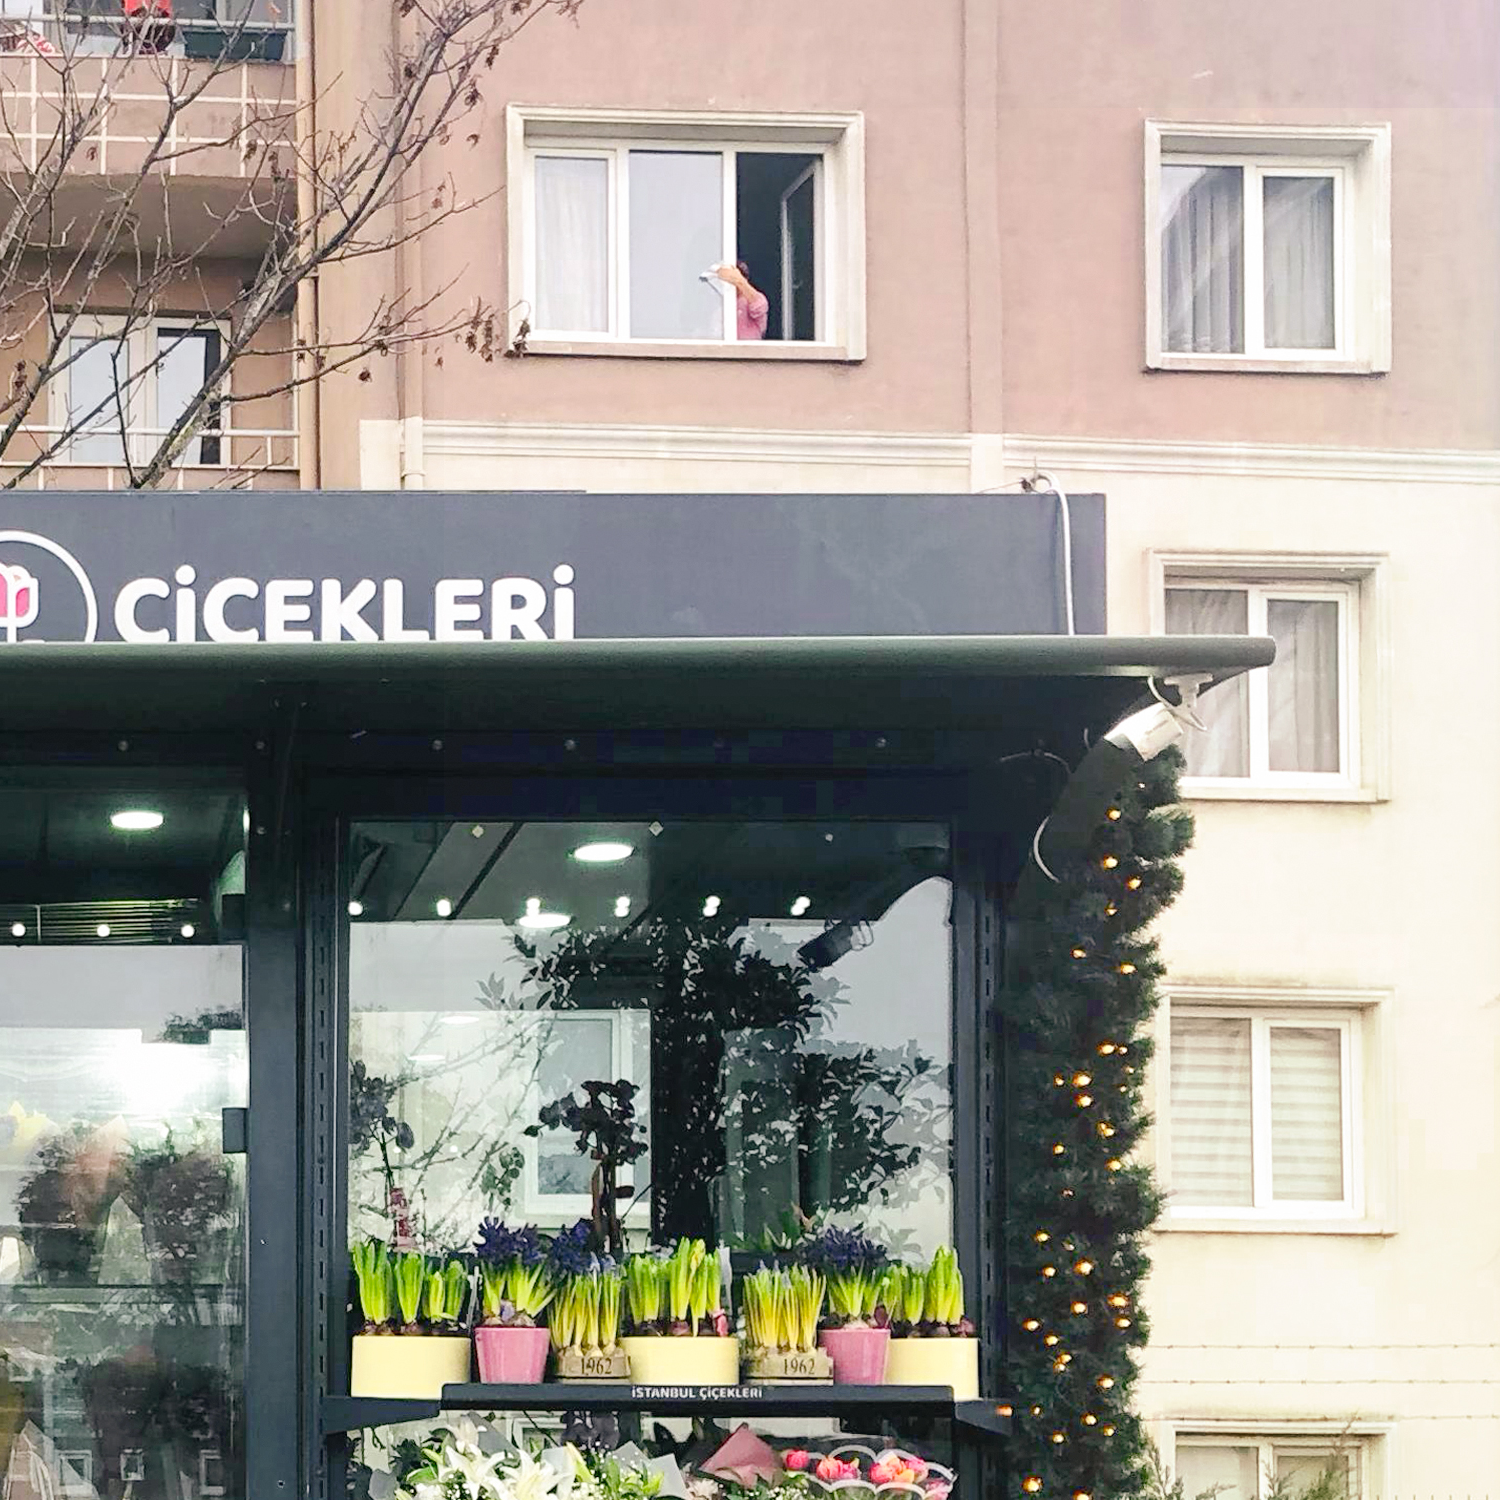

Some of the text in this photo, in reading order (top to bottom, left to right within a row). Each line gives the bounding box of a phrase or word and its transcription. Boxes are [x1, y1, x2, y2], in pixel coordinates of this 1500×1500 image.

[579, 1356, 613, 1376] 1962
[782, 1356, 816, 1376] 1962
[631, 1386, 696, 1399] İSTANBUL
